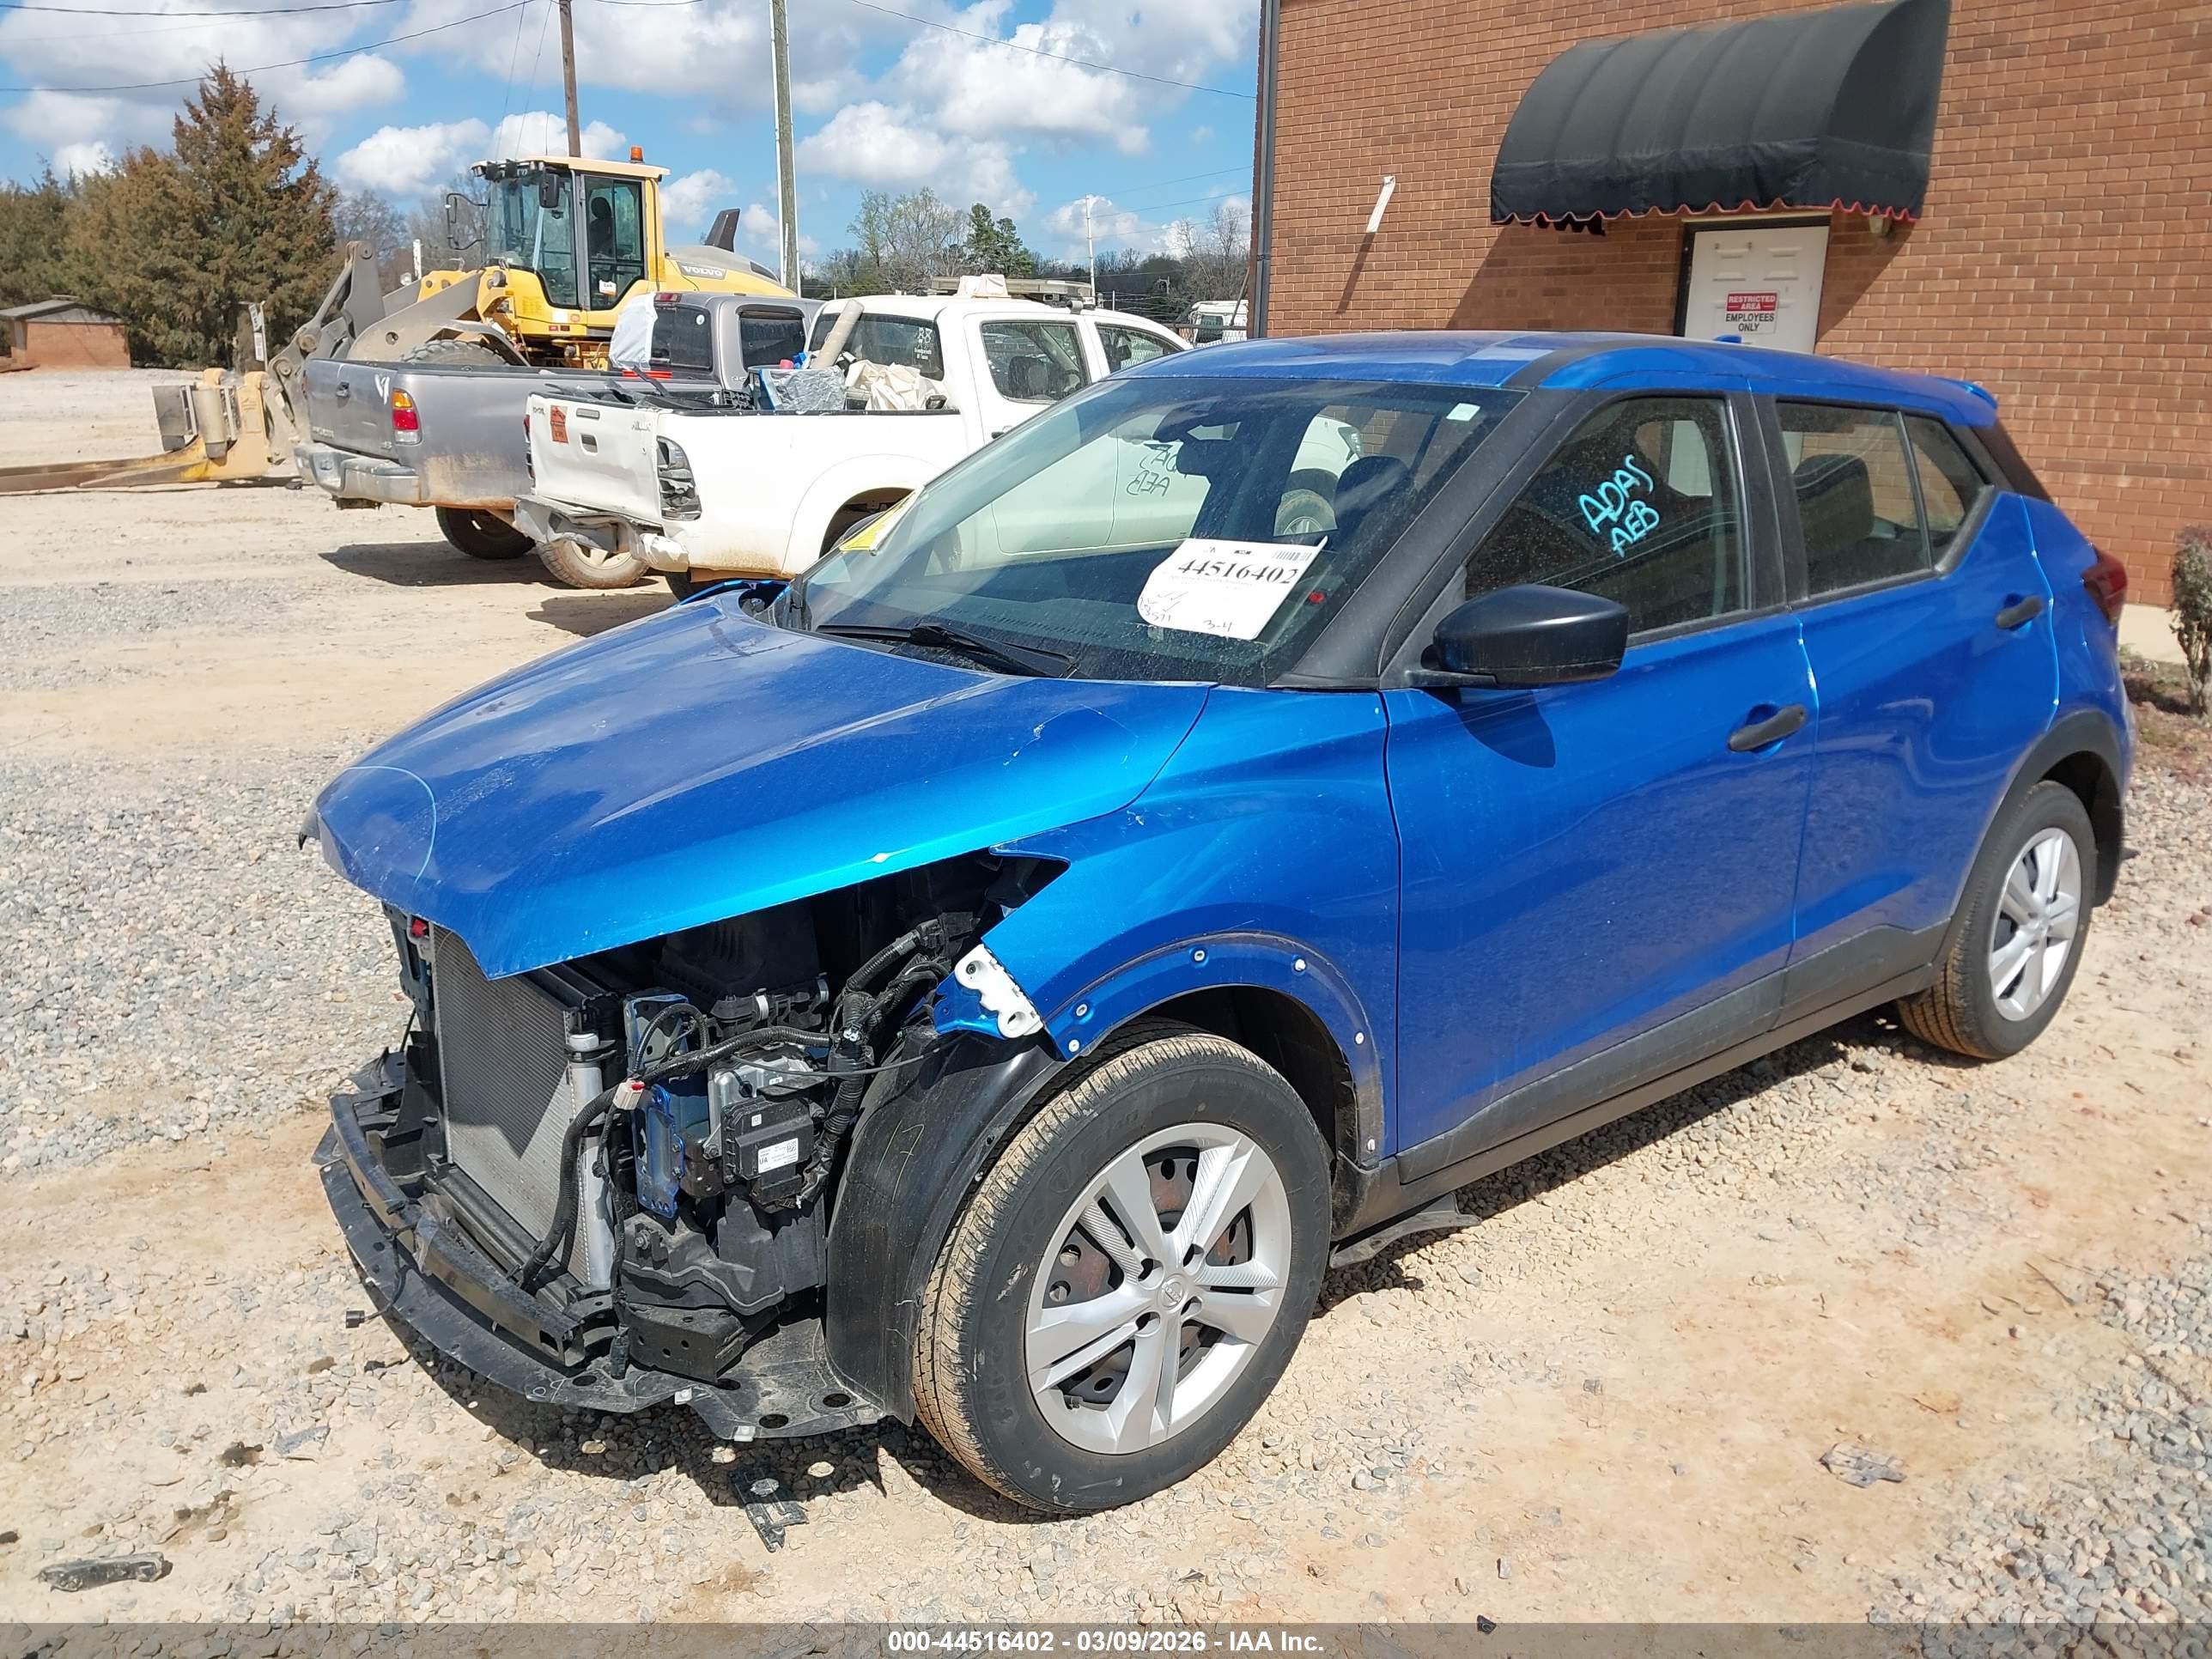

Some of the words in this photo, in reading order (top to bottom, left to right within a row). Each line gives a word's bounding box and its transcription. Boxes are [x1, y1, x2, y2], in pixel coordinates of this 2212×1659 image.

[681, 265, 723, 276] VOLVO
[1725, 313, 1775, 322] EMPLOYEES
[1738, 323, 1759, 331] ONLY
[1579, 453, 1654, 533] ADAS
[1611, 500, 1660, 558] AEB
[1177, 558, 1299, 584] 44516402
